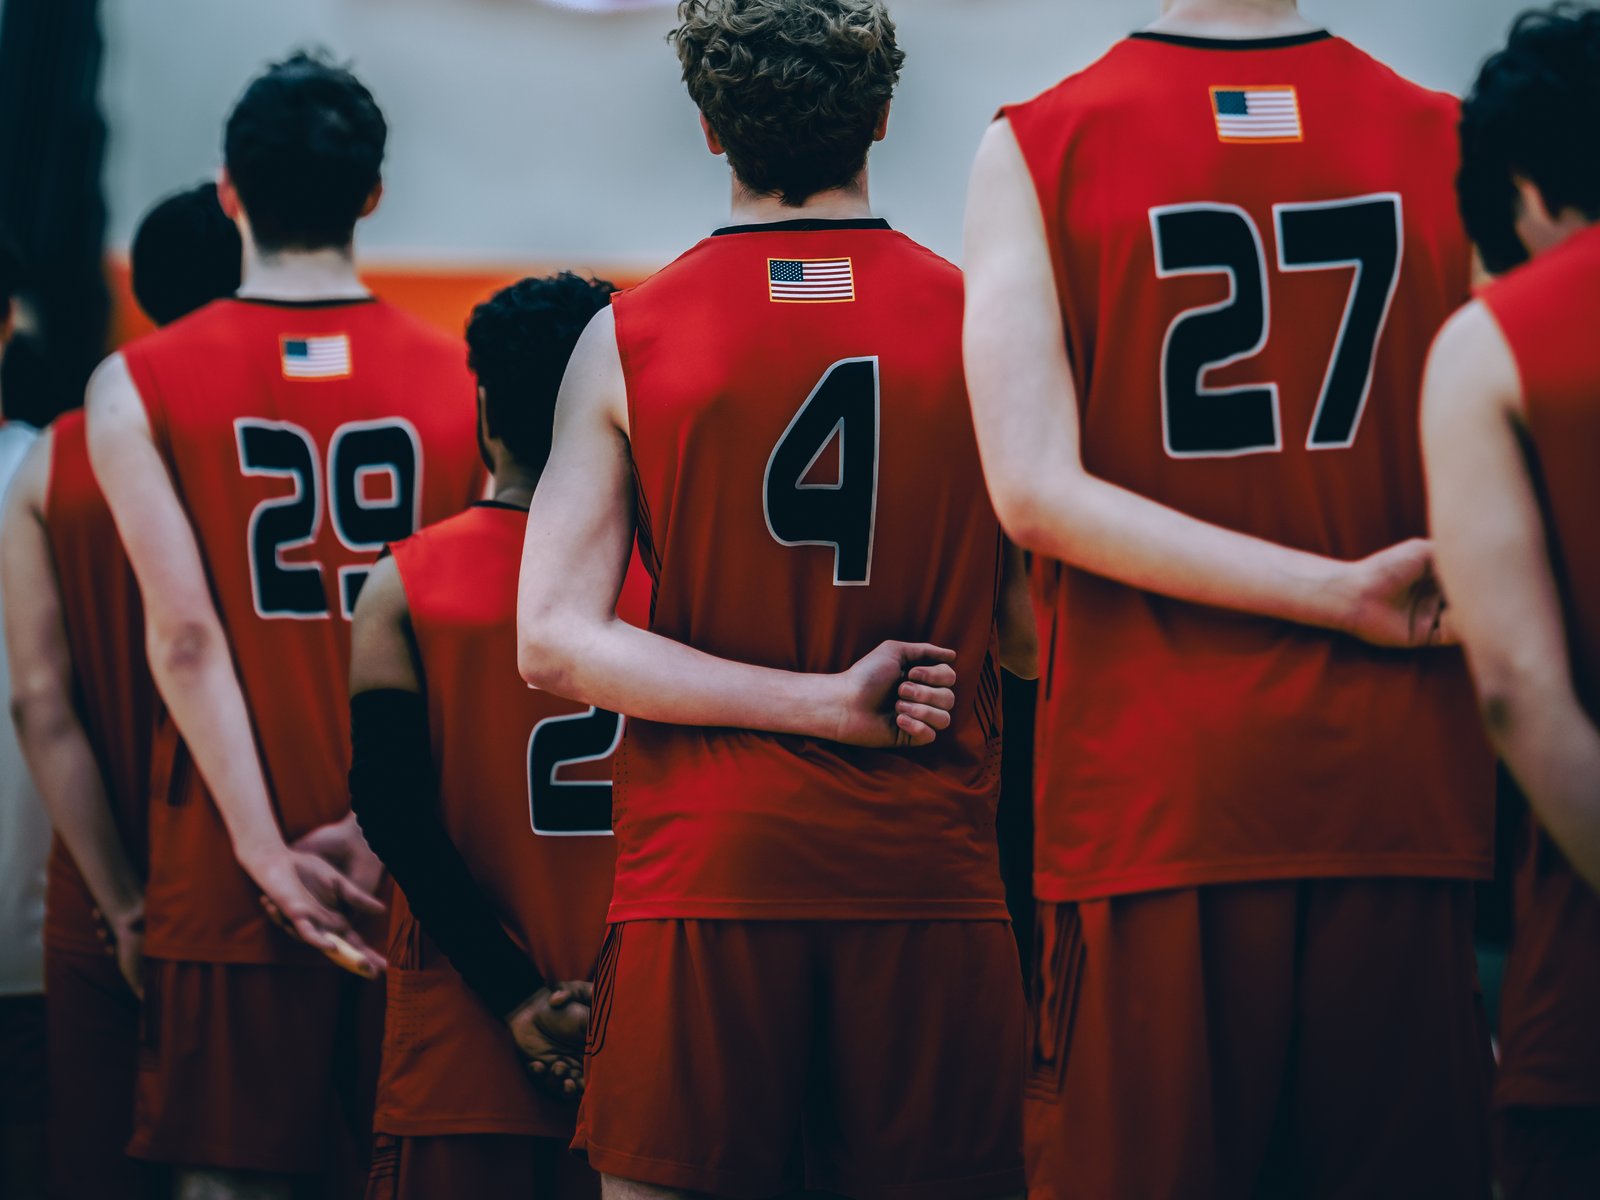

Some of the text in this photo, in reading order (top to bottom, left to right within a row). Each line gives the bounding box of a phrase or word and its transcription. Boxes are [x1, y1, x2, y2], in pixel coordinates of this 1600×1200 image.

[1147, 191, 1403, 458] 27
[233, 416, 423, 621] 29
[763, 355, 881, 587] 4
